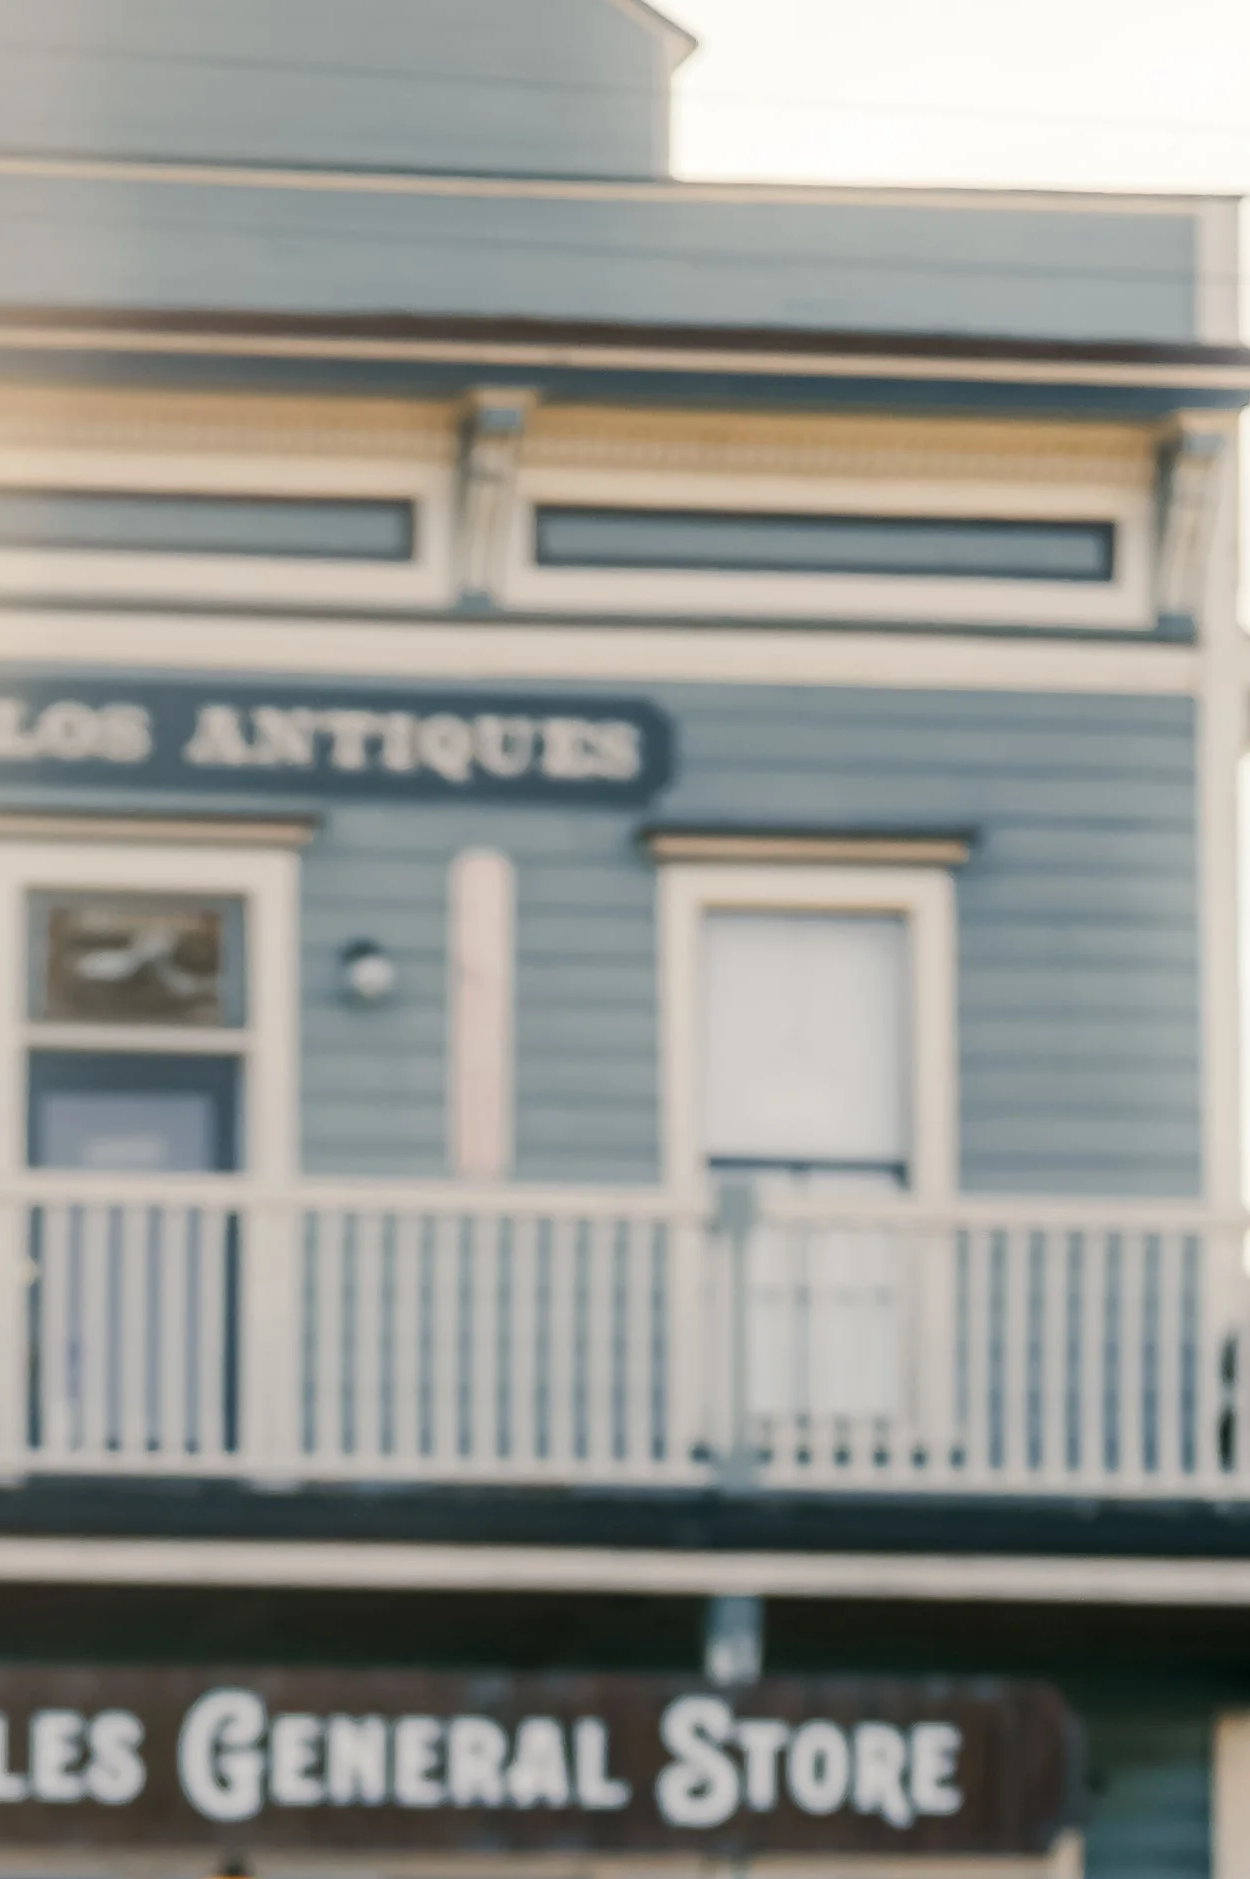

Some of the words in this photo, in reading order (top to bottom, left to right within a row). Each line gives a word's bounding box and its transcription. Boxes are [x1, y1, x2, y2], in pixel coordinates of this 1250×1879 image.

[183, 704, 642, 782] ANTIQUES
[177, 1686, 632, 1822] GENERAL
[655, 1694, 964, 1830] STORE
